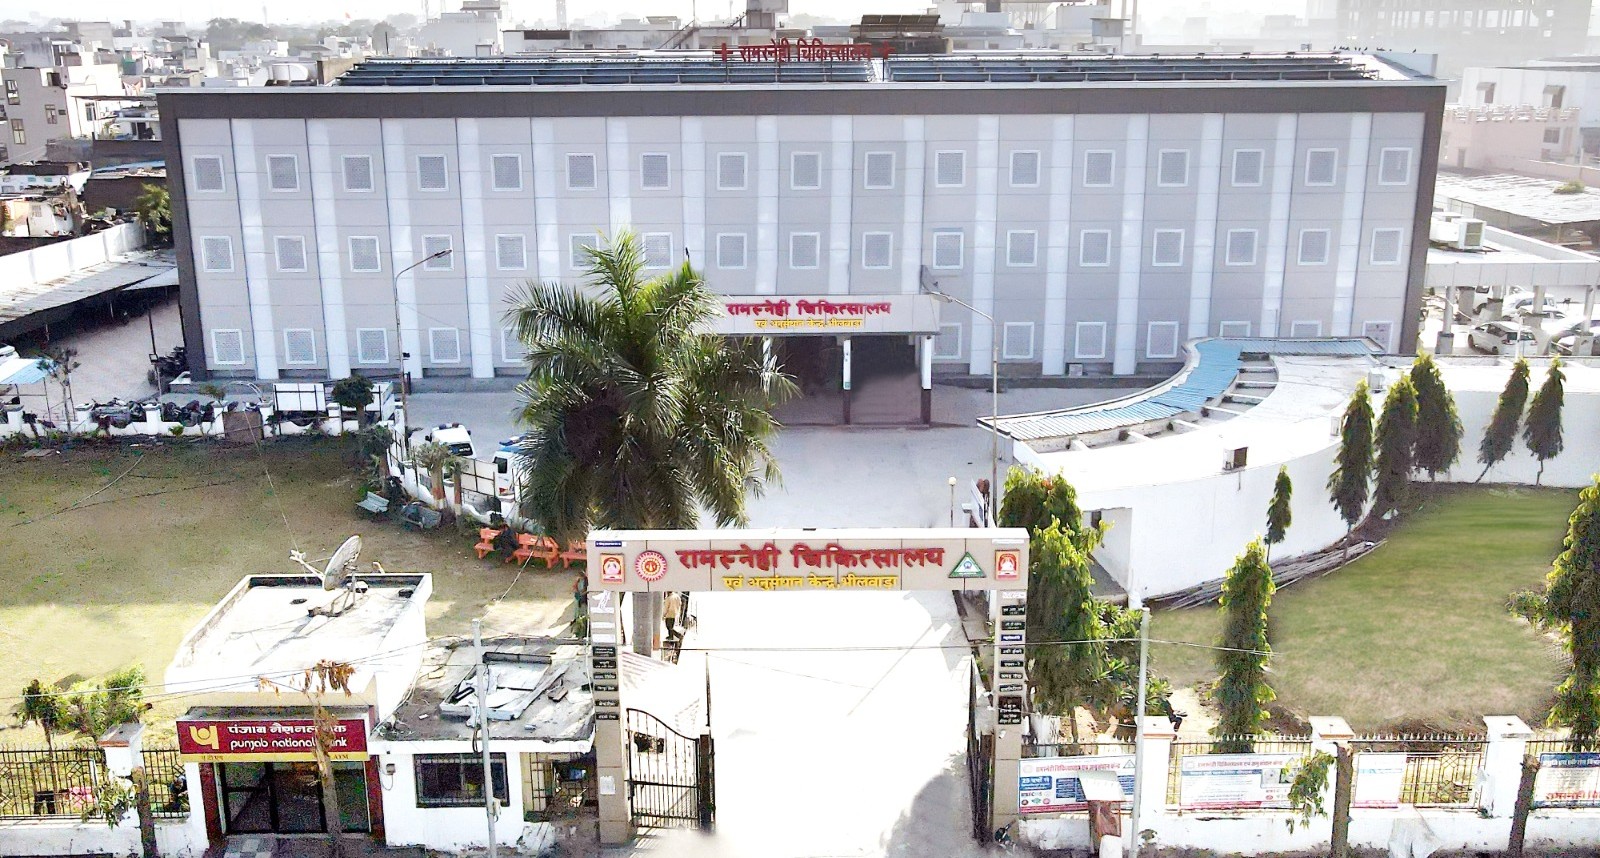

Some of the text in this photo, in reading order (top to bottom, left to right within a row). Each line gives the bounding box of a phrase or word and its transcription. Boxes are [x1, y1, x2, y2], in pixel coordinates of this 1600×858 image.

[726, 299, 892, 316] रामस्नेही चिकित्सालय
[675, 542, 945, 571] रामस्नेही चिकित्सालय
[722, 573, 744, 591] एवं
[748, 573, 804, 591] अनुसंधान
[227, 724, 267, 734] पंजाब
[230, 738, 269, 751] punjab
[272, 737, 316, 748] national
